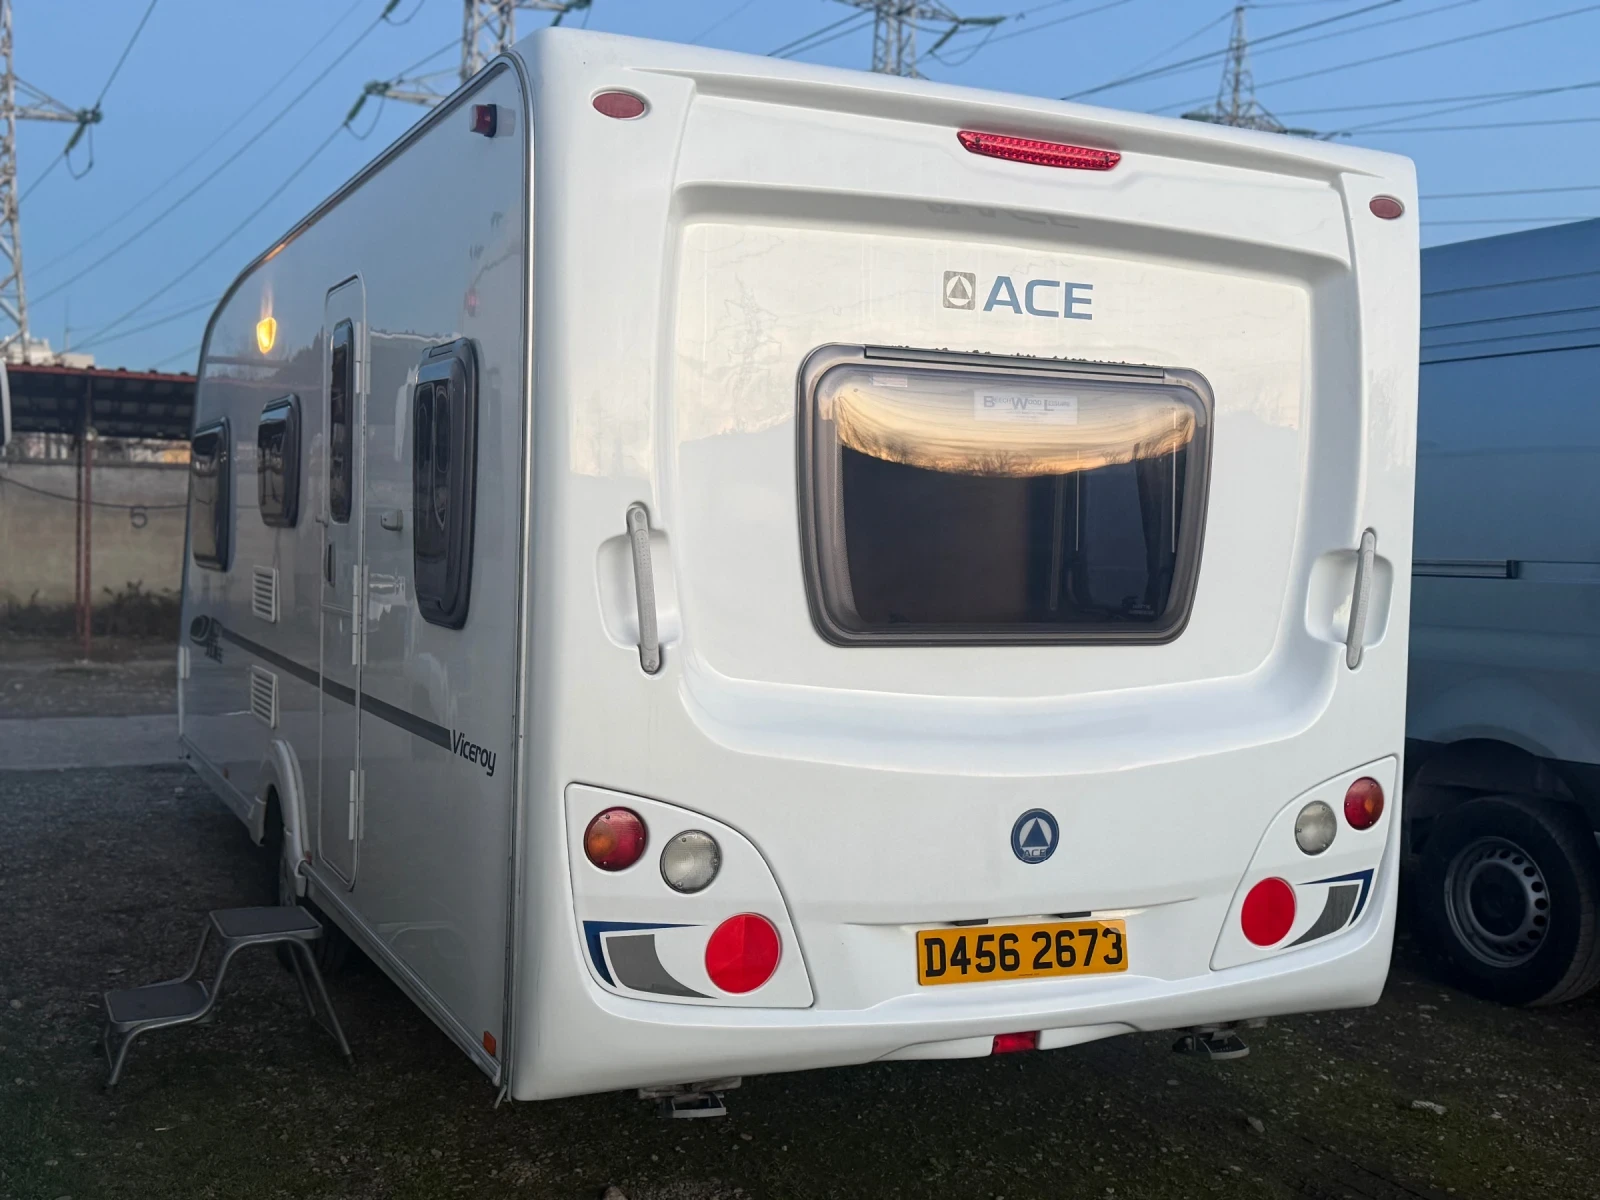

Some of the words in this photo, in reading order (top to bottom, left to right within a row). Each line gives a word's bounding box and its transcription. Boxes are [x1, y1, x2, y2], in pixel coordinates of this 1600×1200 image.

[983, 275, 1094, 321] ACE
[453, 729, 497, 777] Viceroy
[1023, 848, 1047, 858] ACE
[924, 932, 1020, 978] D456
[1031, 927, 1123, 970] 2673
